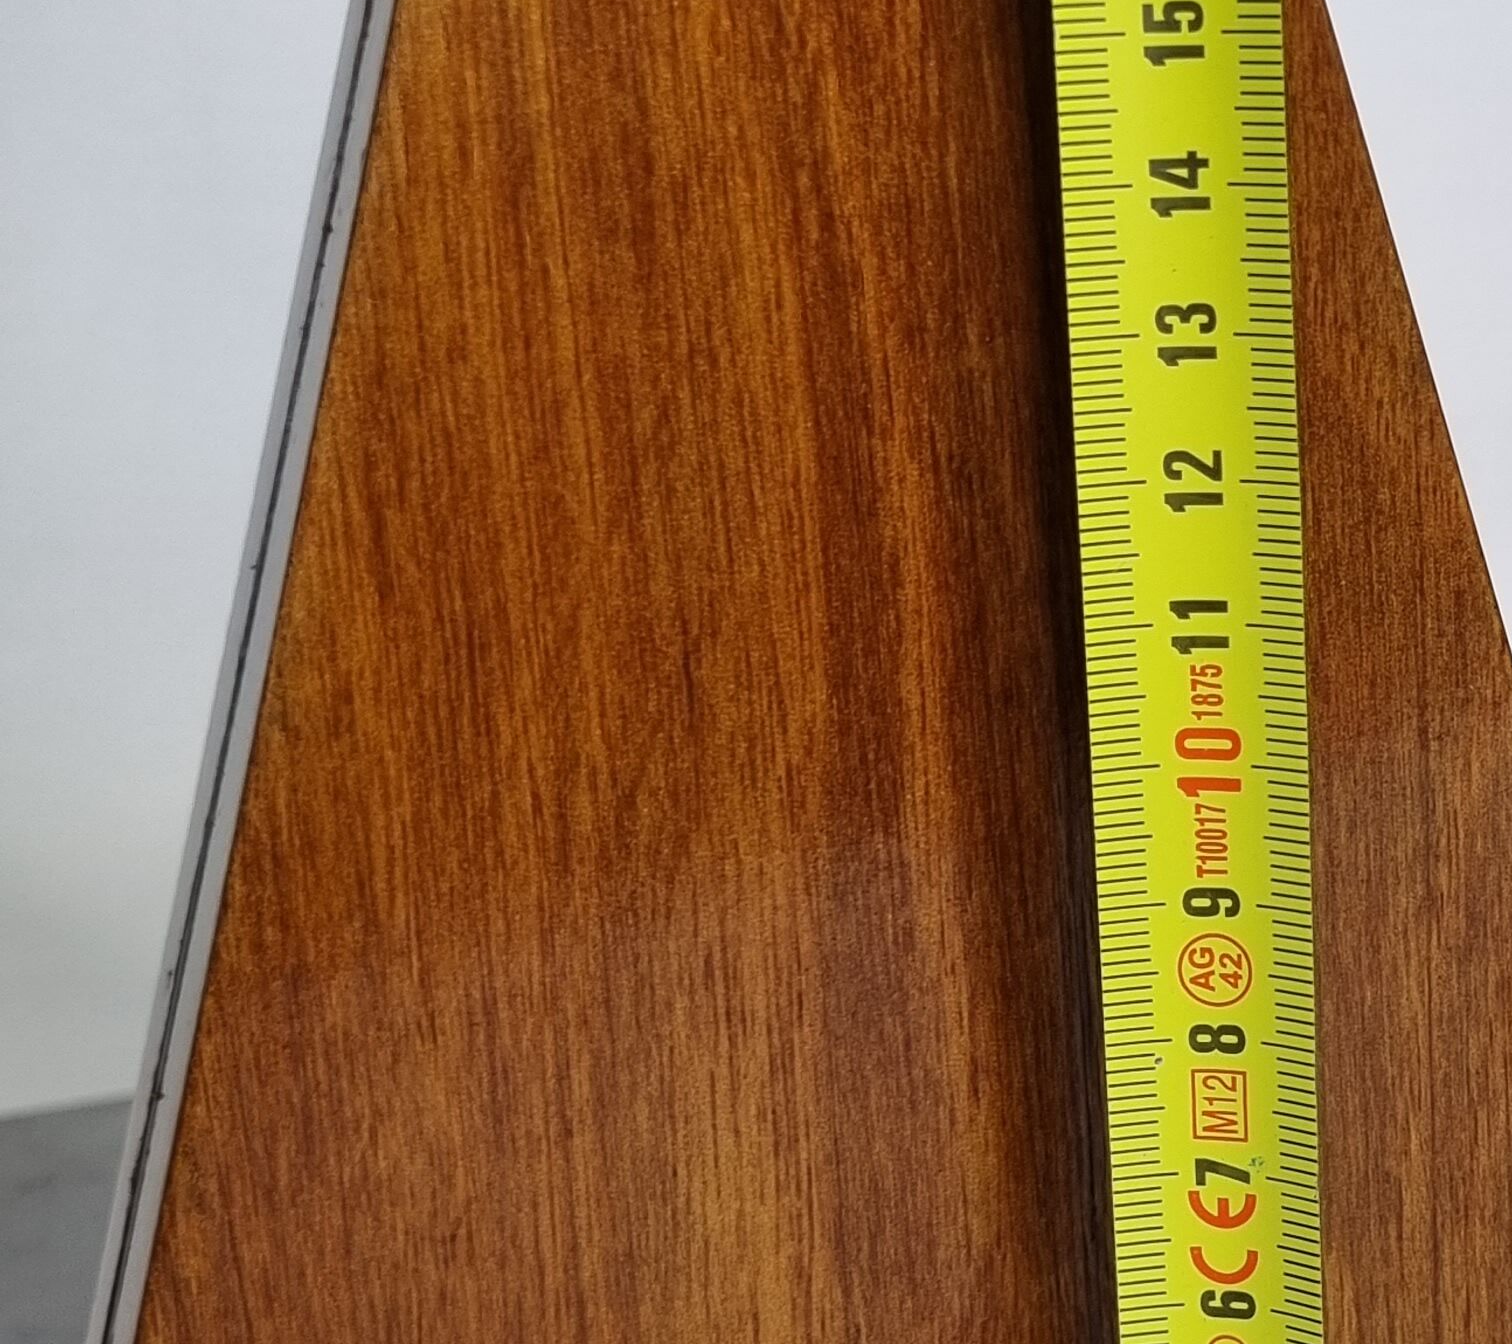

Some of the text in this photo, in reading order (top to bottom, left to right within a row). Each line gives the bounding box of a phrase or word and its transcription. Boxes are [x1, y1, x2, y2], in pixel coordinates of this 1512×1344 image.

[1142, 0, 1205, 66] 15
[1148, 150, 1211, 218] 14
[1154, 302, 1218, 367] 13
[1163, 450, 1224, 513] 12
[1169, 599, 1230, 655] 11
[1190, 663, 1224, 720] 1875
[1175, 727, 1242, 798] 10
[1194, 802, 1229, 878] T10017
[1182, 887, 1241, 918] 9
[1189, 941, 1217, 996] AG
[1218, 950, 1247, 991] 42
[1188, 1024, 1246, 1055] 8
[1200, 1073, 1239, 1135] M12
[1194, 1158, 1251, 1186] 7
[1200, 1289, 1257, 1320] 6
